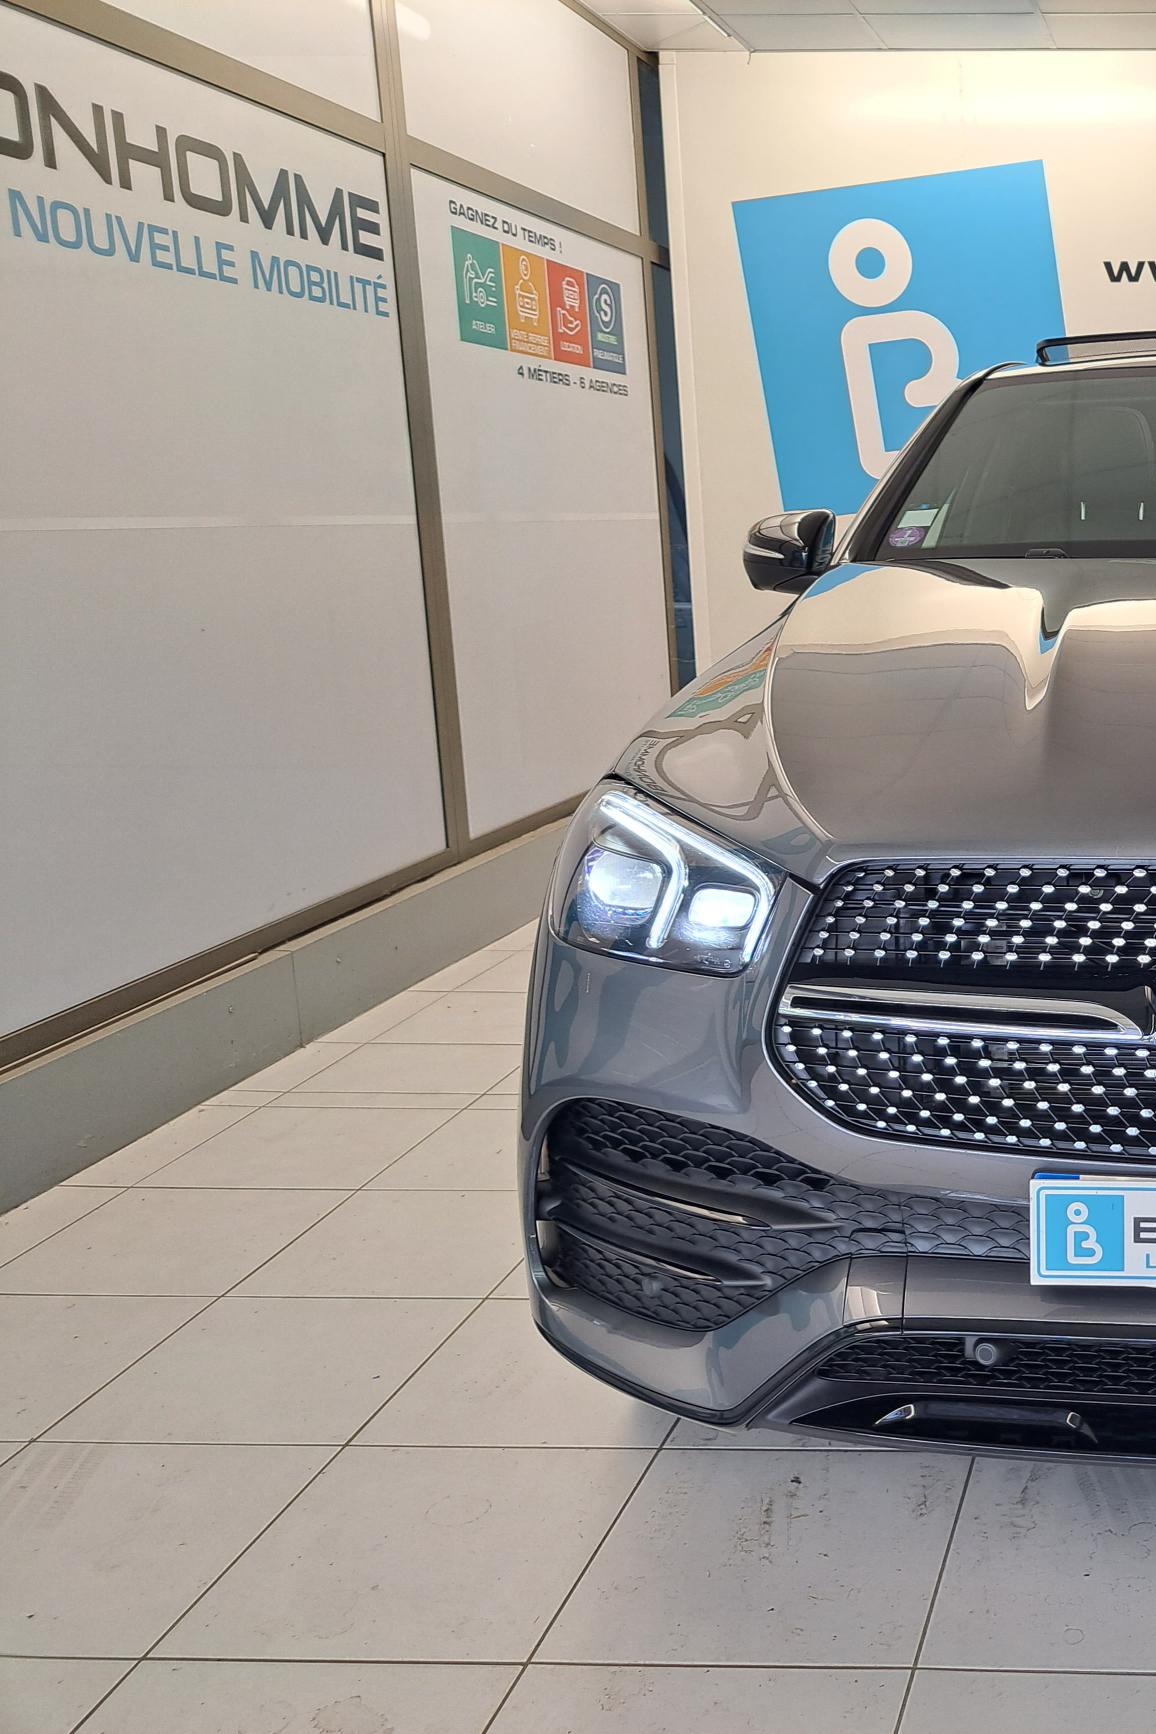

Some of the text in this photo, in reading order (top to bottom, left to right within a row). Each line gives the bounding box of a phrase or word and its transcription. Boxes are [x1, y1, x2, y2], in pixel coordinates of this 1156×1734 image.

[449, 200, 498, 230] GAGNEZ
[502, 220, 518, 237] DU
[521, 227, 556, 252] TEMPS
[8, 188, 390, 318] NOUVELLE MOBILITÉ
[517, 366, 525, 378] 4
[528, 365, 571, 387] MÉTIERS
[579, 377, 586, 390] 6
[588, 379, 629, 397] AGENCES
